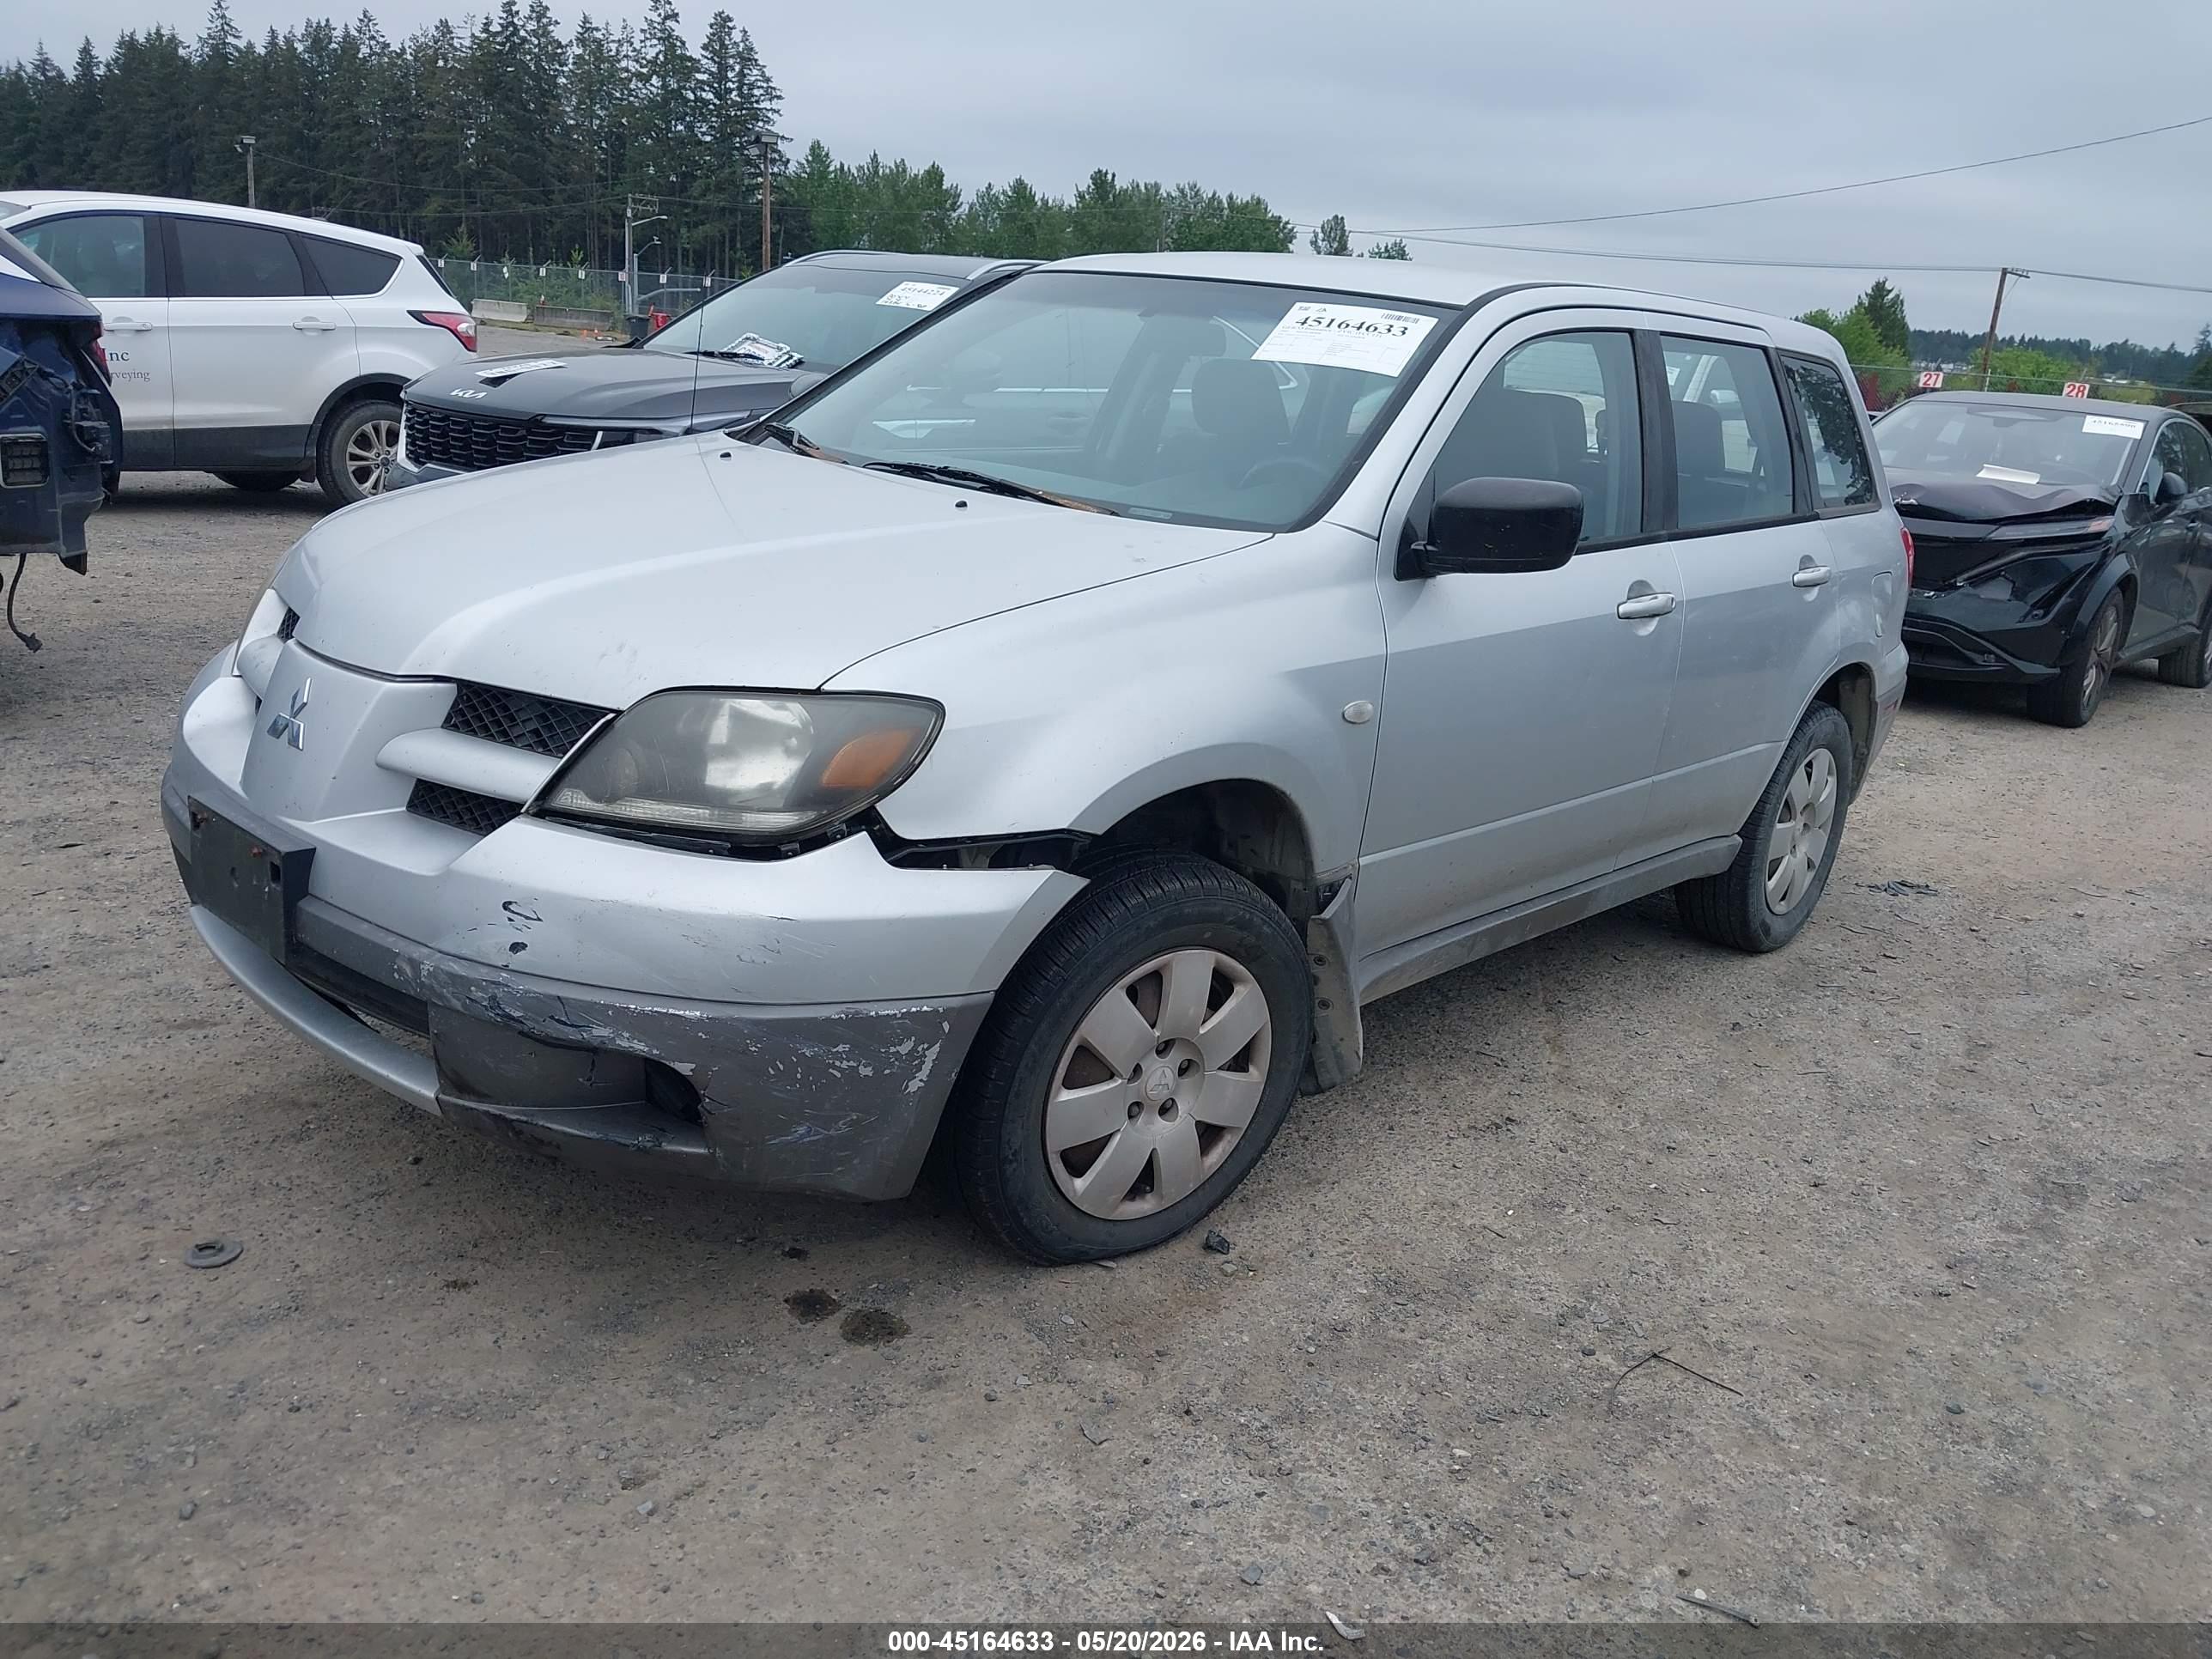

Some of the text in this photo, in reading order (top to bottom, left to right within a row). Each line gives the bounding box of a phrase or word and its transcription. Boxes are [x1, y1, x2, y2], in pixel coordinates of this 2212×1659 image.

[1295, 315, 1408, 337] 45164633
[1923, 373, 1941, 386] 27
[2067, 383, 2087, 398] 28
